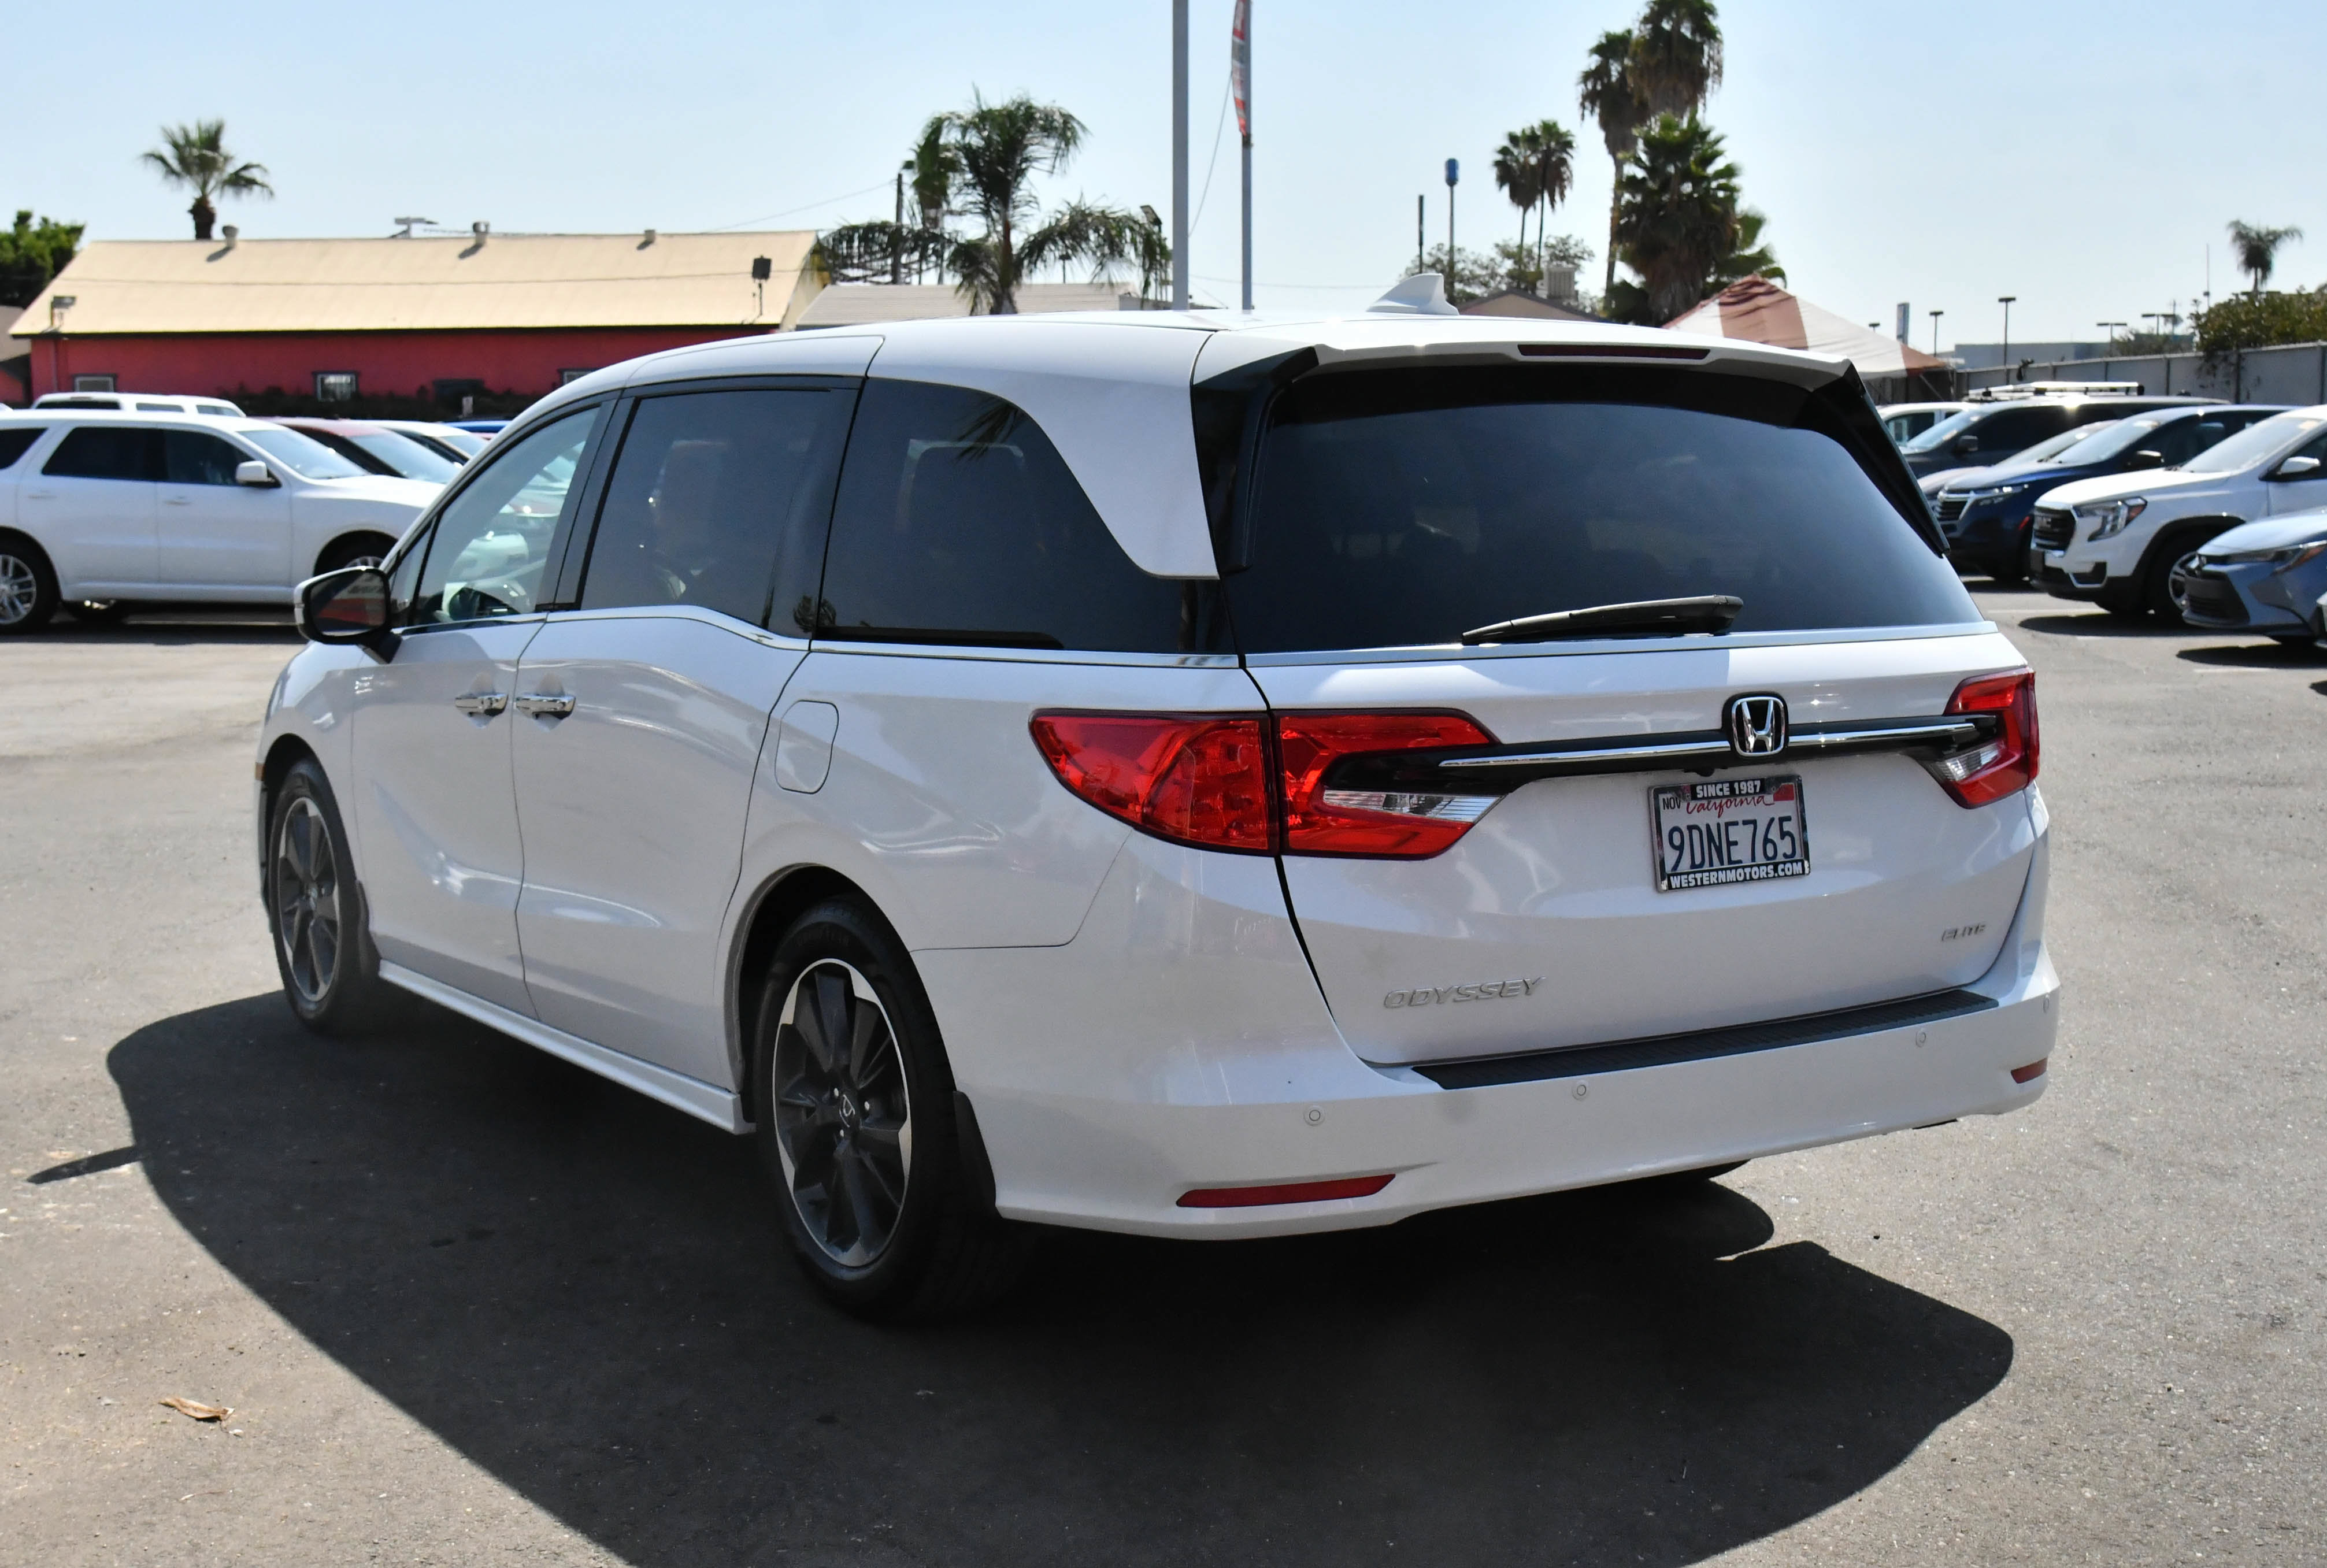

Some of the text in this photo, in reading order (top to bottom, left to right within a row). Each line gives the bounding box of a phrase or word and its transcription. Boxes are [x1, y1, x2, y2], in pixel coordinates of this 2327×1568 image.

[1696, 780, 1761, 798] SINCE 1987
[1663, 797, 1681, 810] NOV
[1668, 815, 1796, 872] 9DNE765
[1670, 862, 1803, 888] WESTERNMOTORS.COM
[1384, 976, 1546, 1009] ODYSSEY
